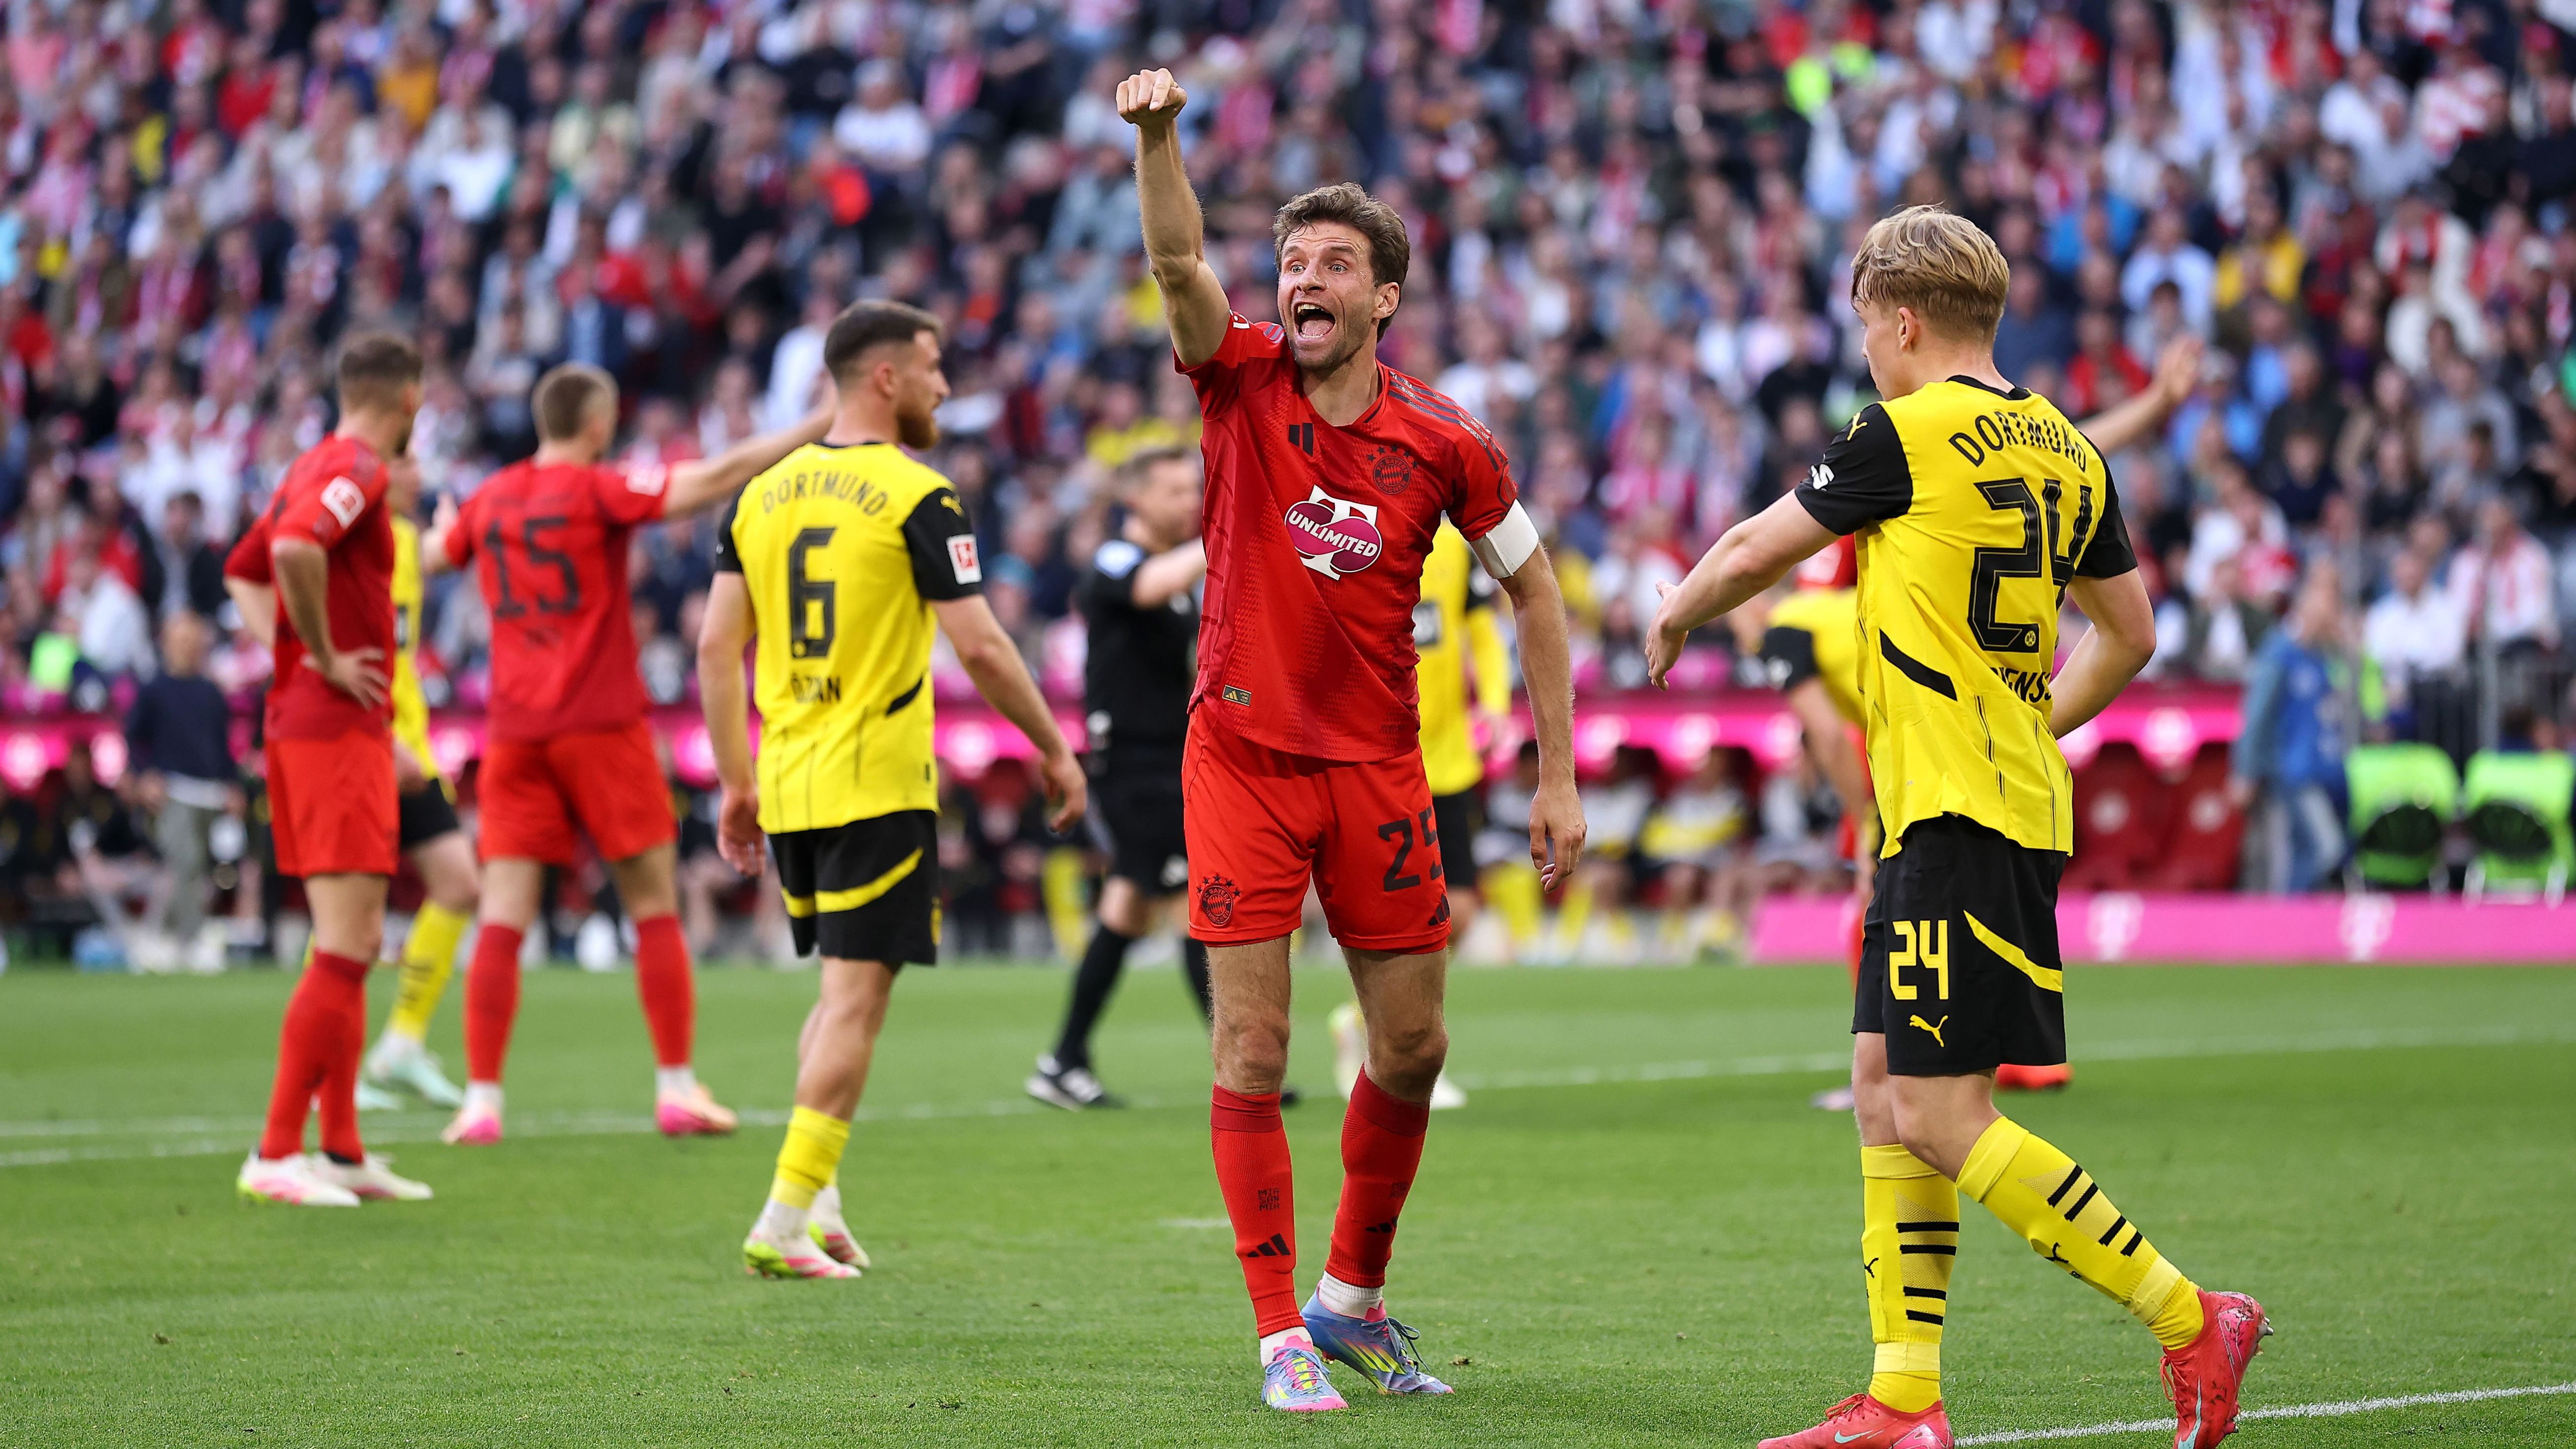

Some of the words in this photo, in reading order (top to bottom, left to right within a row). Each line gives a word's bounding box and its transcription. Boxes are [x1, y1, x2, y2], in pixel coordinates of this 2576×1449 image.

[1948, 411, 2086, 473] DORTMUND
[762, 471, 888, 517] DORTMUND
[484, 516, 580, 615] 15
[1288, 510, 1378, 557] UNLIMITED
[1967, 477, 2093, 653] 24
[788, 526, 837, 659] 6
[1209, 888, 1231, 904] BAYERN
[1889, 920, 1949, 1000] 24
